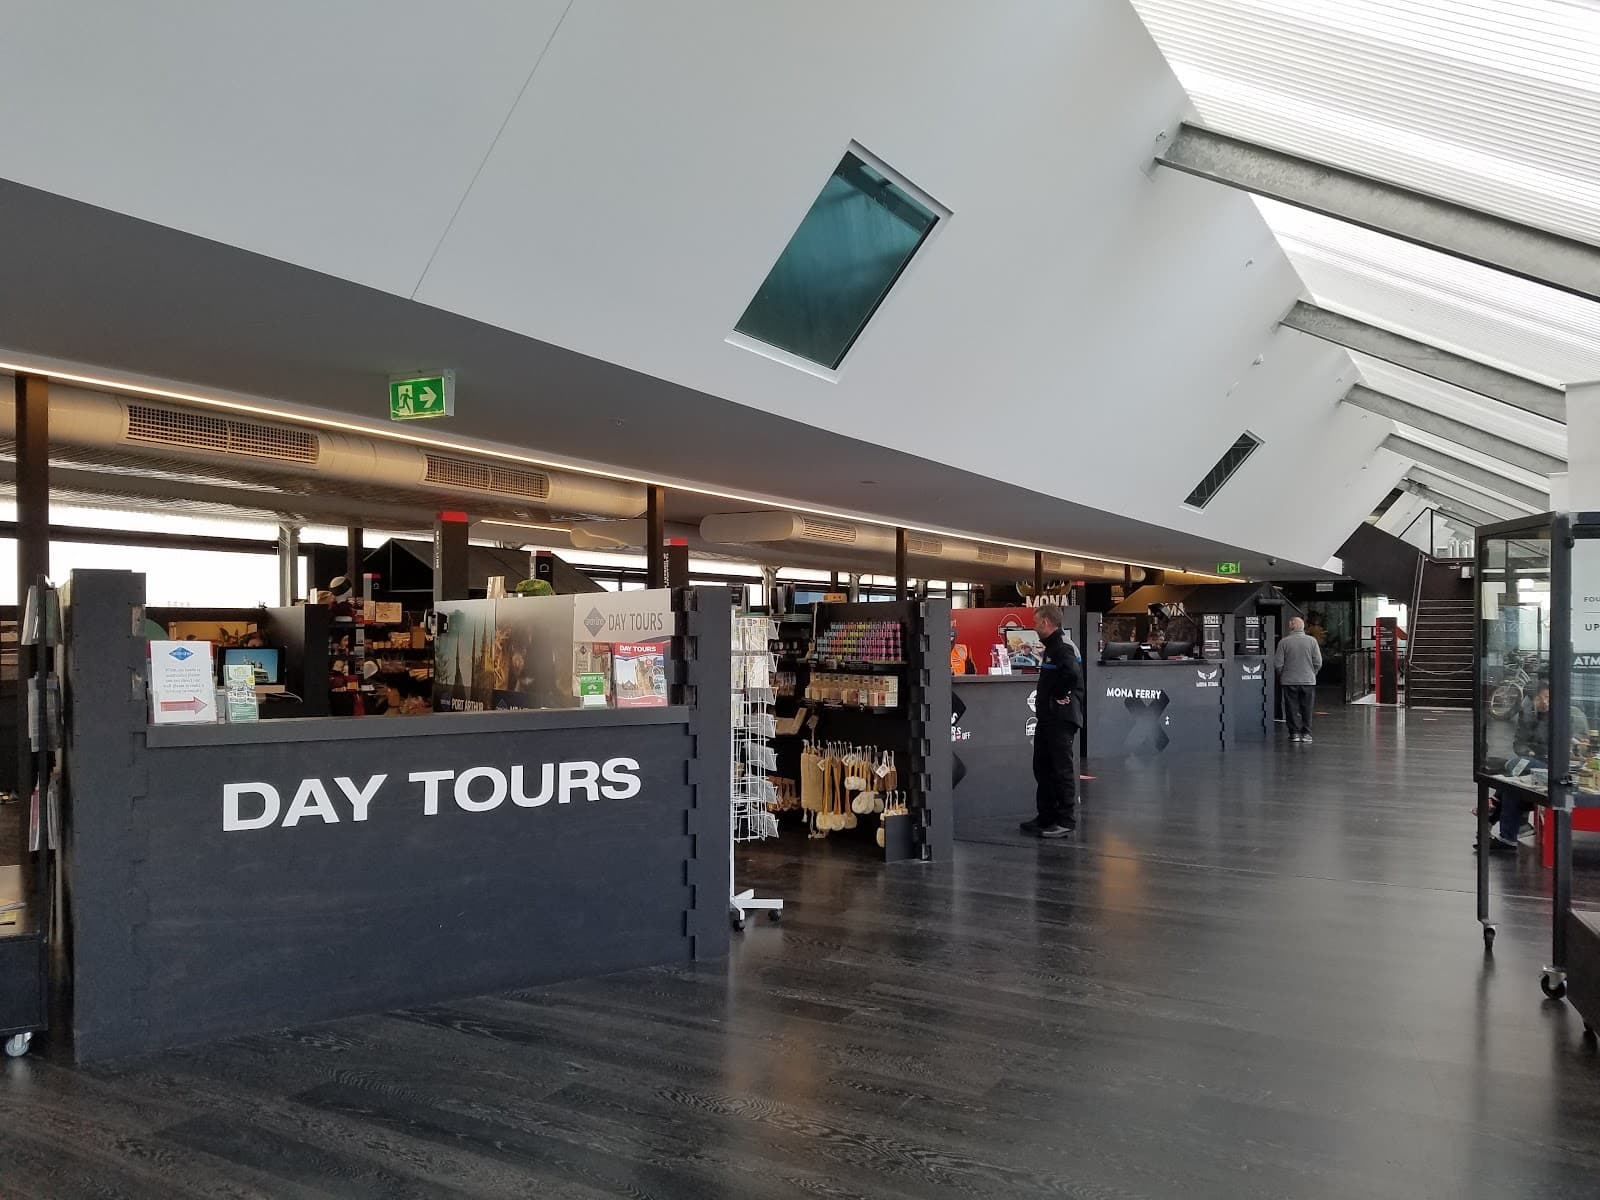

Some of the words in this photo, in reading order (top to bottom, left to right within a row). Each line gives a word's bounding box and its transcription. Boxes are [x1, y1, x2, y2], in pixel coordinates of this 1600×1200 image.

[1026, 594, 1068, 608] MONA
[608, 613, 627, 631] DAY
[629, 612, 663, 631] TOURS
[1573, 656, 1600, 666] ATM
[1106, 688, 1133, 698] MONA
[1135, 688, 1162, 700] FERRY
[451, 698, 464, 711] PORT
[223, 774, 389, 832] DAY
[408, 757, 641, 816] TOURS
